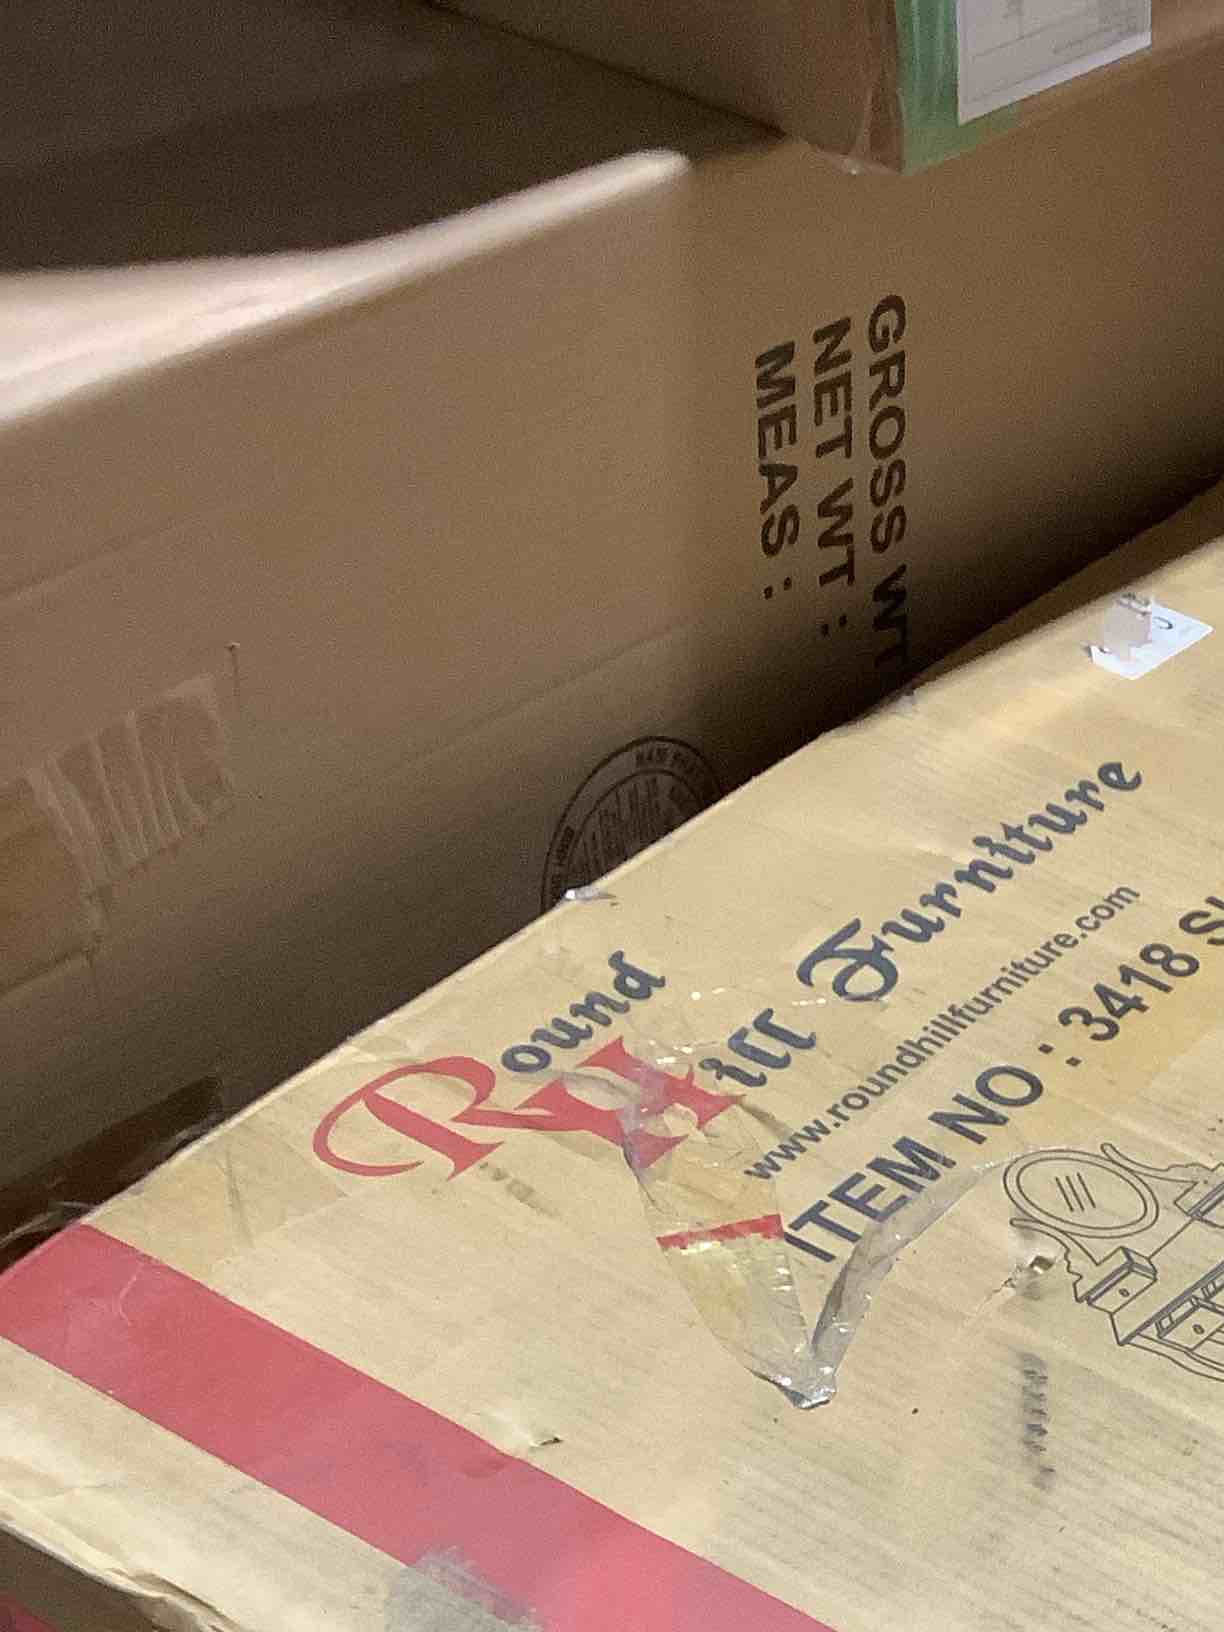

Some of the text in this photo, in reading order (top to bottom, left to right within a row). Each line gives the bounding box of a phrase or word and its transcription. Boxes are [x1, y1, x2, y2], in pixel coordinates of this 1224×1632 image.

[755, 341, 799, 557] MEAS
[812, 316, 853, 459] NET
[868, 294, 906, 554] GROSS
[817, 477, 855, 587] WT
[796, 761, 1143, 1004] Furniture
[744, 885, 1141, 1182] www.roundhillfurniture.com
[784, 1135, 957, 1264] ITEM
[928, 1064, 1045, 1146] NO
[1057, 942, 1201, 1043] 3418
